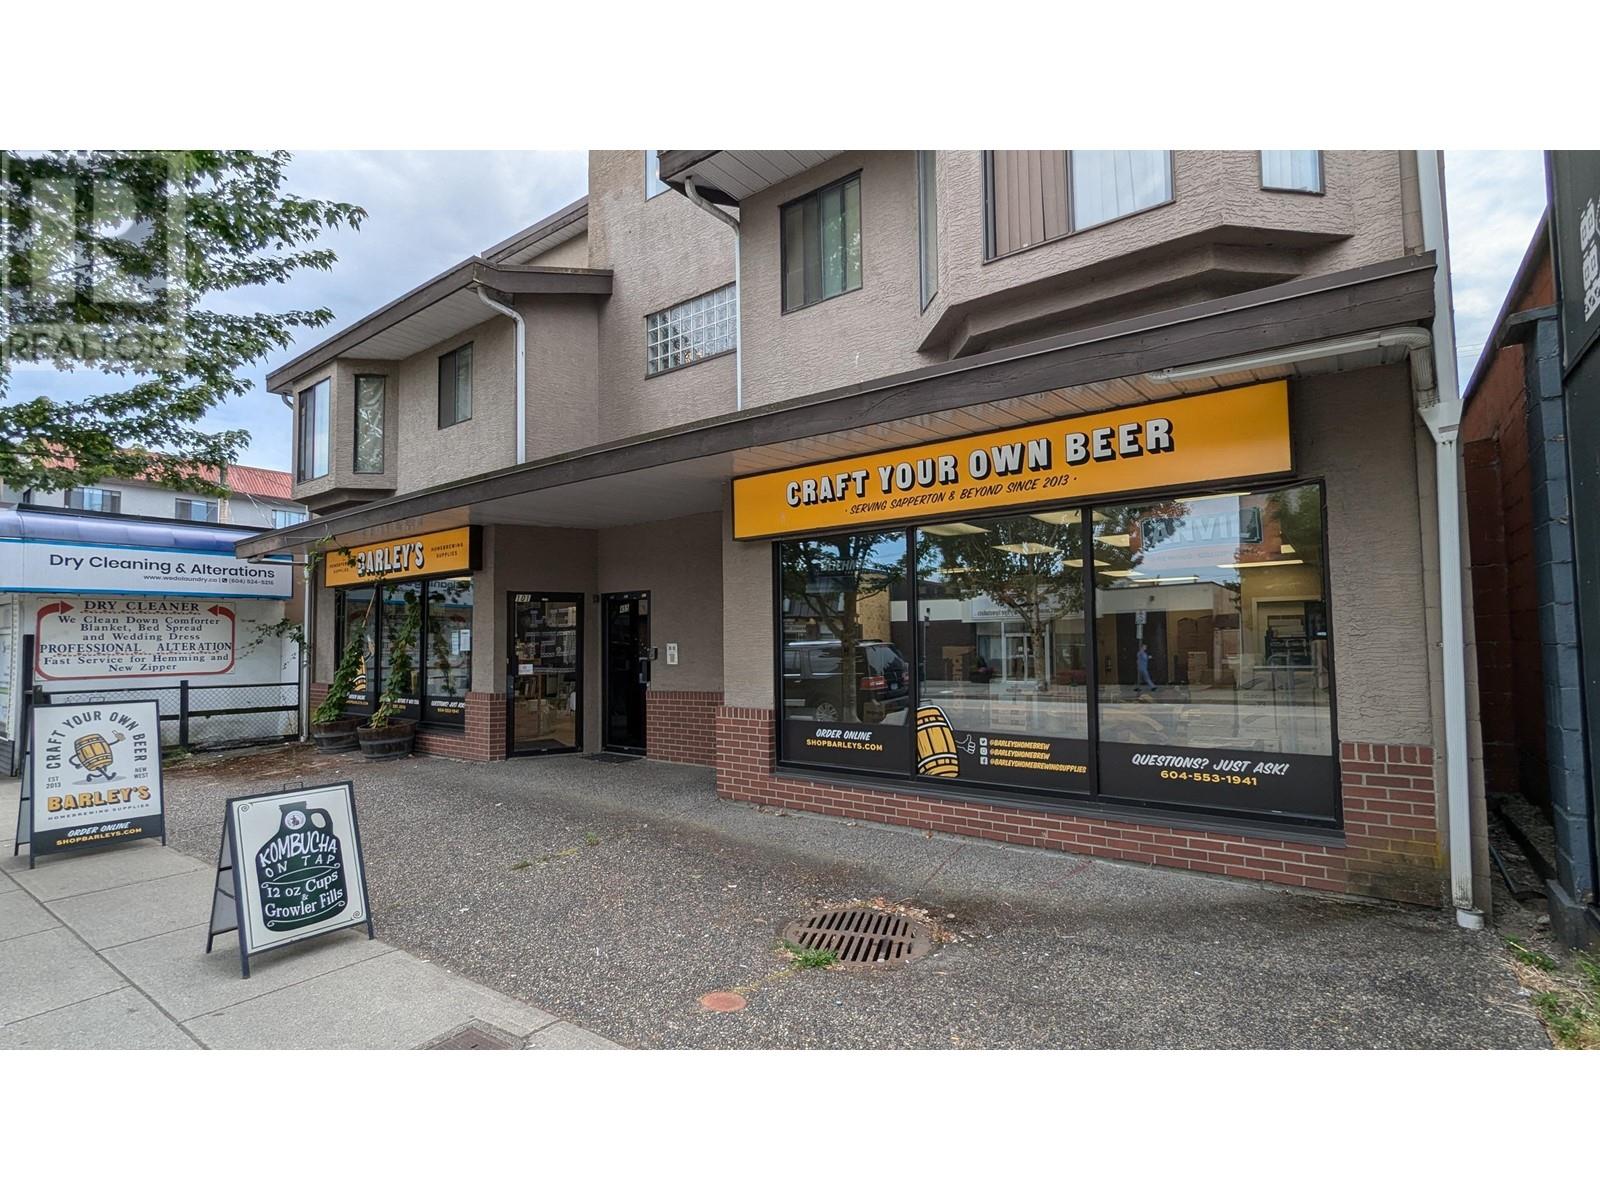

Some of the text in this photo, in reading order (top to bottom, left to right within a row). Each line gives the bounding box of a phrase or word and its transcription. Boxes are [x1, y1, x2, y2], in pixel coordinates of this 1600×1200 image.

[786, 418, 1175, 507] CRAFT YOUR OWN BEER
[850, 474, 1070, 515] SERVING SAPPERTON & BEYOND SINCE 2013
[50, 553, 275, 578] Dry Cleaning & Alterations
[357, 542, 424, 577] BARLEY'S
[84, 600, 200, 612] DRY CLEANER
[58, 615, 221, 626] We Clean Down Comforter
[80, 623, 203, 634] Blanket, Bed Spread
[82, 632, 201, 643] and Wedding Dress
[40, 642, 232, 654] PROFESSIONAL ALTERATION
[44, 653, 229, 665] Fast Service for Hemming and
[108, 662, 177, 673] New Zipper
[46, 710, 148, 769] CRAFT YOUR OWN BEER
[816, 728, 873, 740] ORDER ONLINE
[806, 739, 883, 751] SHOPBARLEYS.COM
[1131, 753, 1290, 776] QUESTIONS? JUST ASK!
[1160, 770, 1257, 786] 604-553-1941
[47, 785, 151, 812] BARLEY'S
[56, 827, 143, 846] SHOPBARLEYS.COM
[67, 821, 131, 838] ORDER ONLINE
[259, 831, 338, 867] KOMBUCHA
[265, 855, 335, 878] ON TAP
[266, 871, 338, 898] 12 oz Cups
[265, 887, 343, 918] Growler Fills
[301, 893, 309, 901] &
